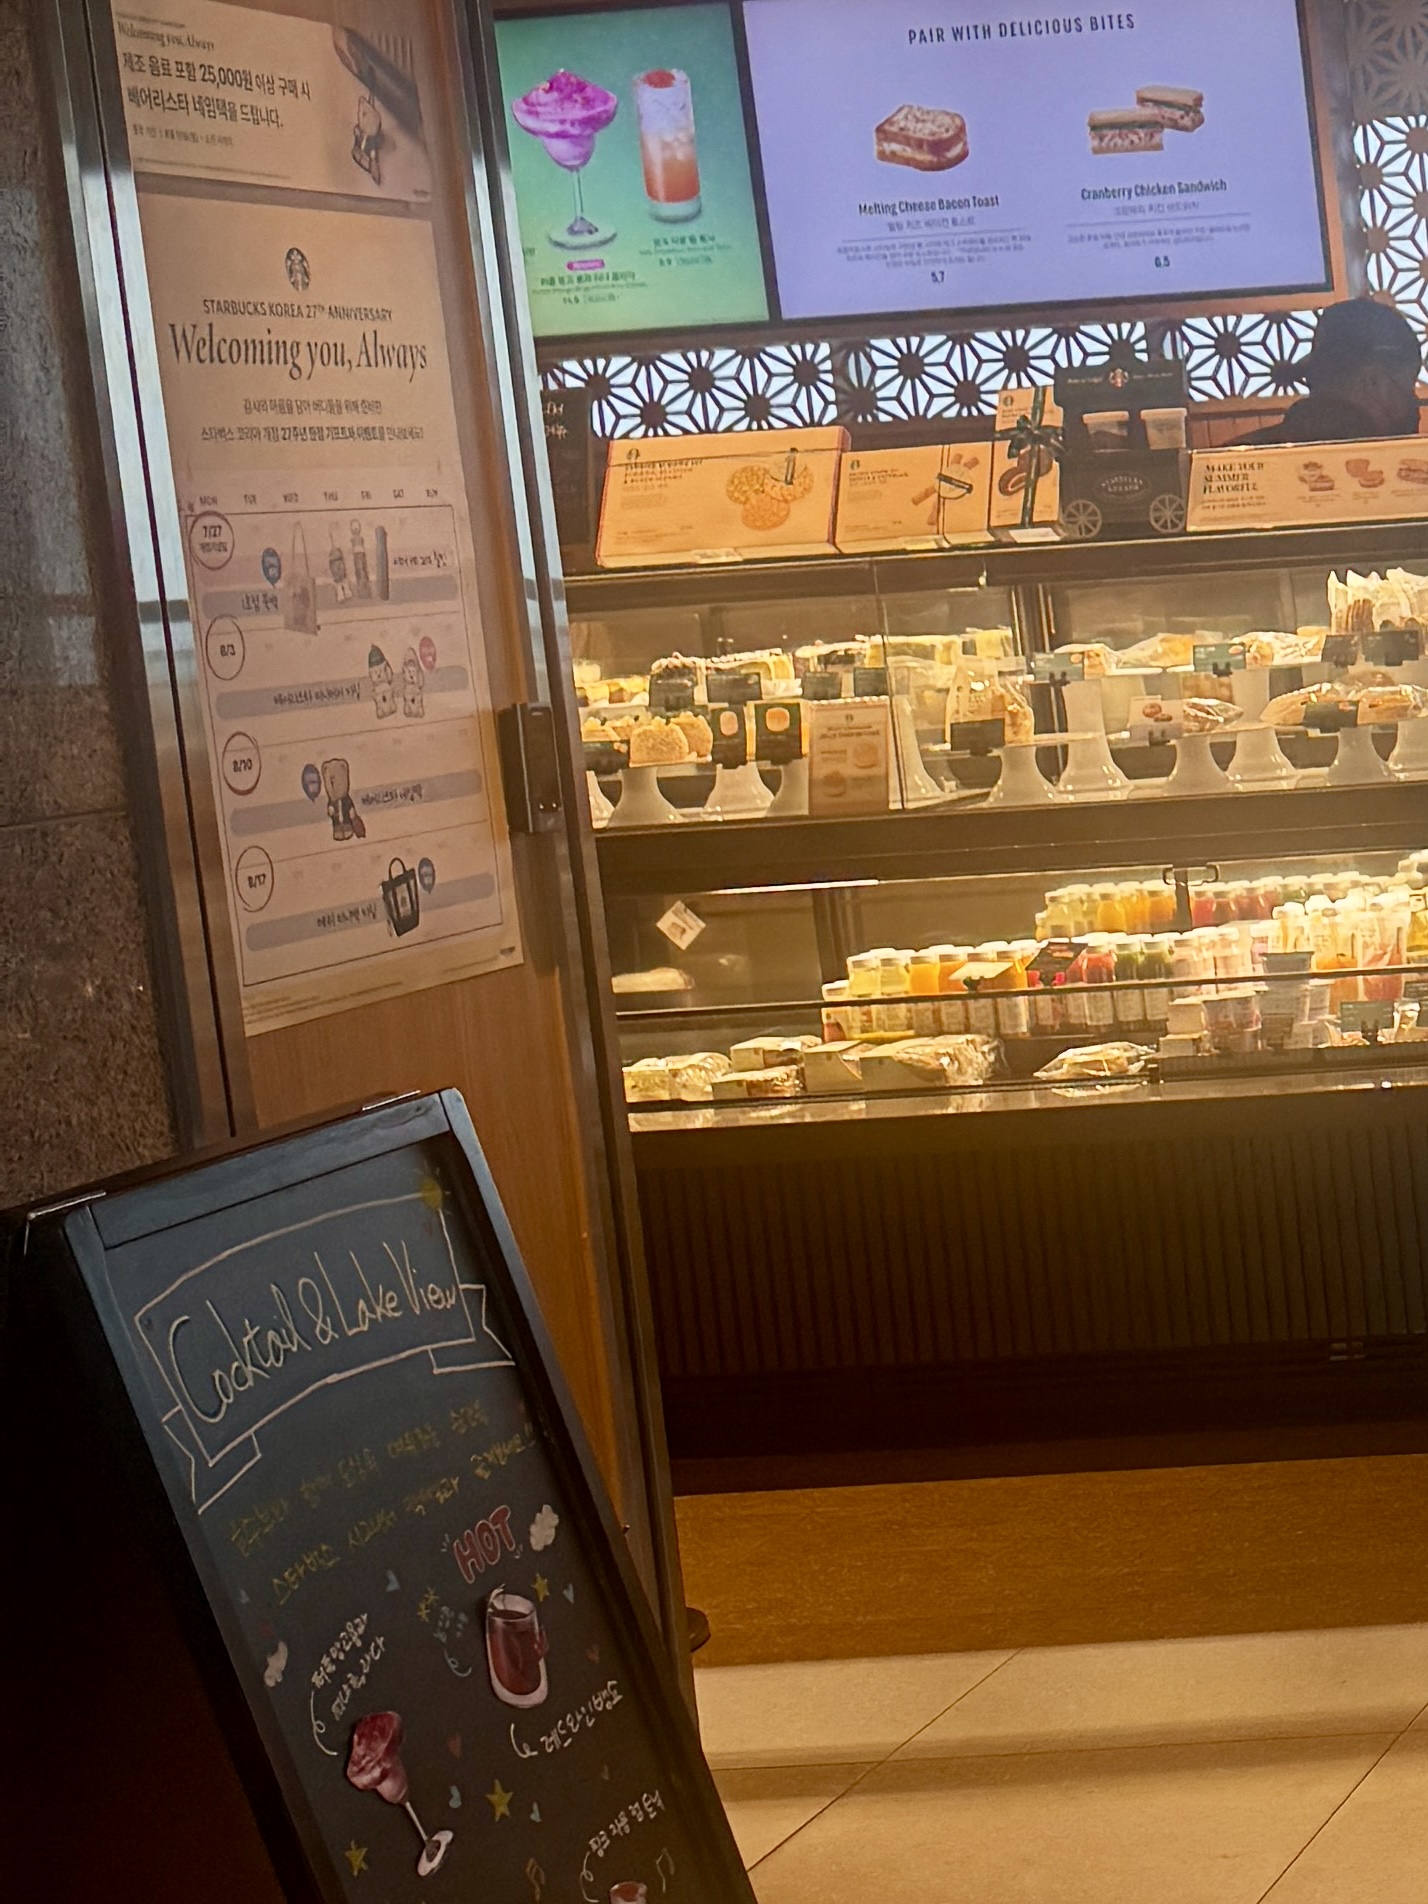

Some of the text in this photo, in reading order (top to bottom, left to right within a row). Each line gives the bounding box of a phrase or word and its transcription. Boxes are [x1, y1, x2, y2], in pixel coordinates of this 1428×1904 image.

[908, 13, 1135, 45] PAIR WITH DELICIOUS BITES
[149, 56, 172, 77] 음료
[174, 60, 197, 82] 포함
[199, 64, 253, 91] 25,000원
[938, 198, 970, 211] Bacon
[972, 195, 999, 208] Toast
[203, 299, 267, 316] STARBUCKS
[268, 303, 304, 318] KOREA
[168, 322, 428, 383] Welcoming you, Always
[169, 1239, 457, 1424] Cocktail & Lake View
[453, 1504, 516, 1584] HOT
